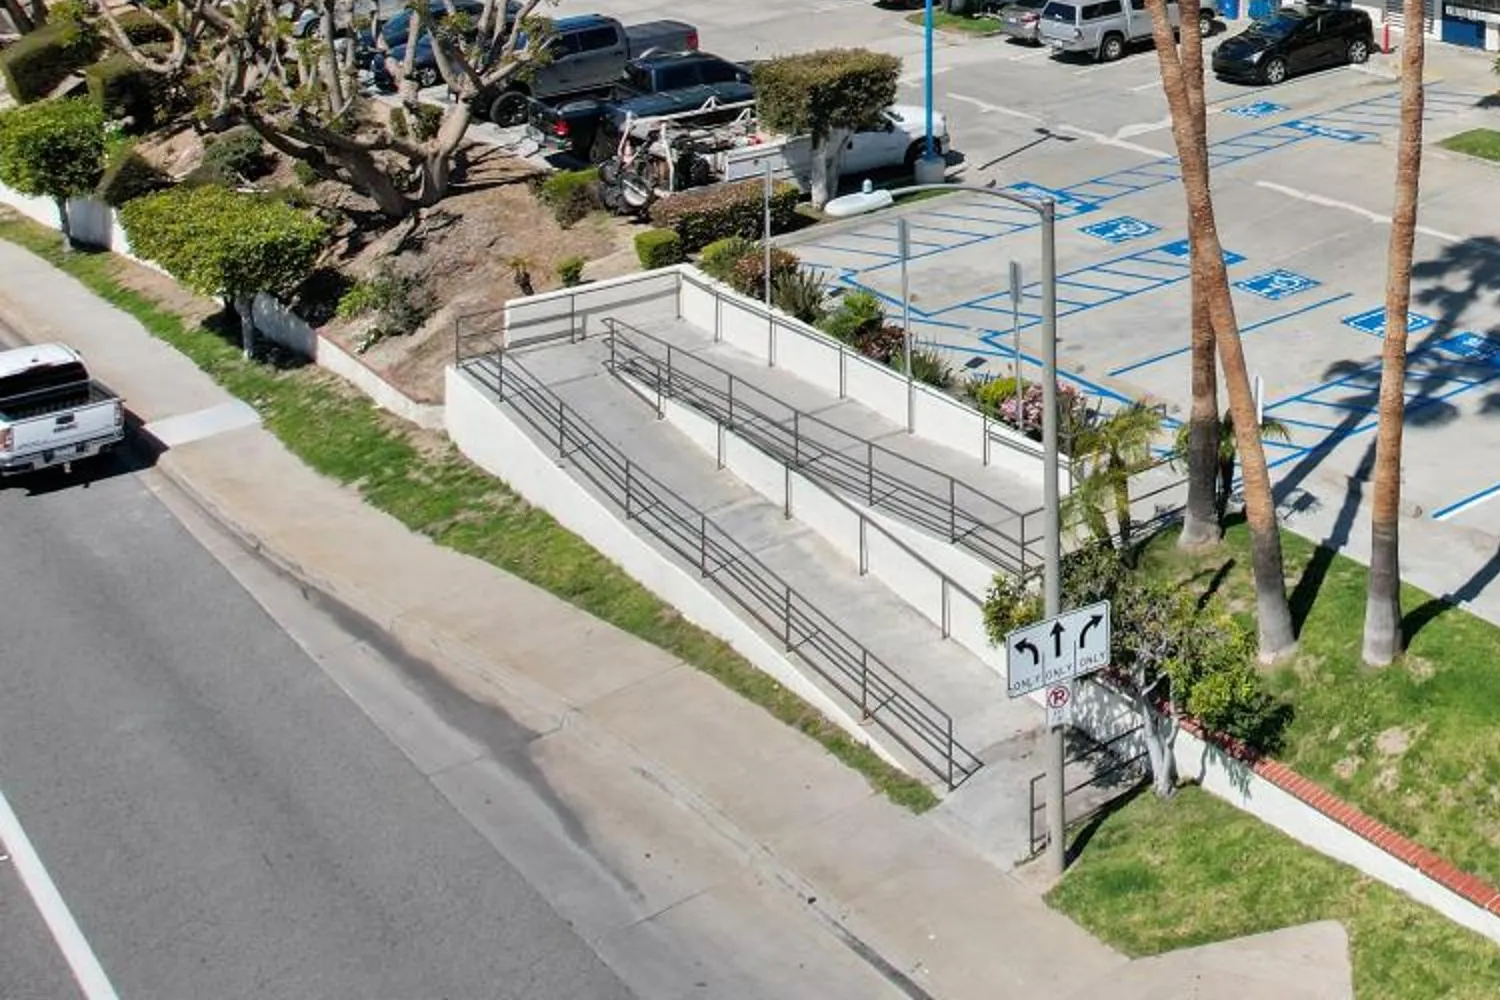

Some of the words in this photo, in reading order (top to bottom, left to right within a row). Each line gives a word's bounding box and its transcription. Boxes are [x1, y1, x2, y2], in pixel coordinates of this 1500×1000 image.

[1080, 652, 1106, 668] ONLY
[1046, 664, 1073, 681] ONLY
[1013, 675, 1040, 691] ONLY
